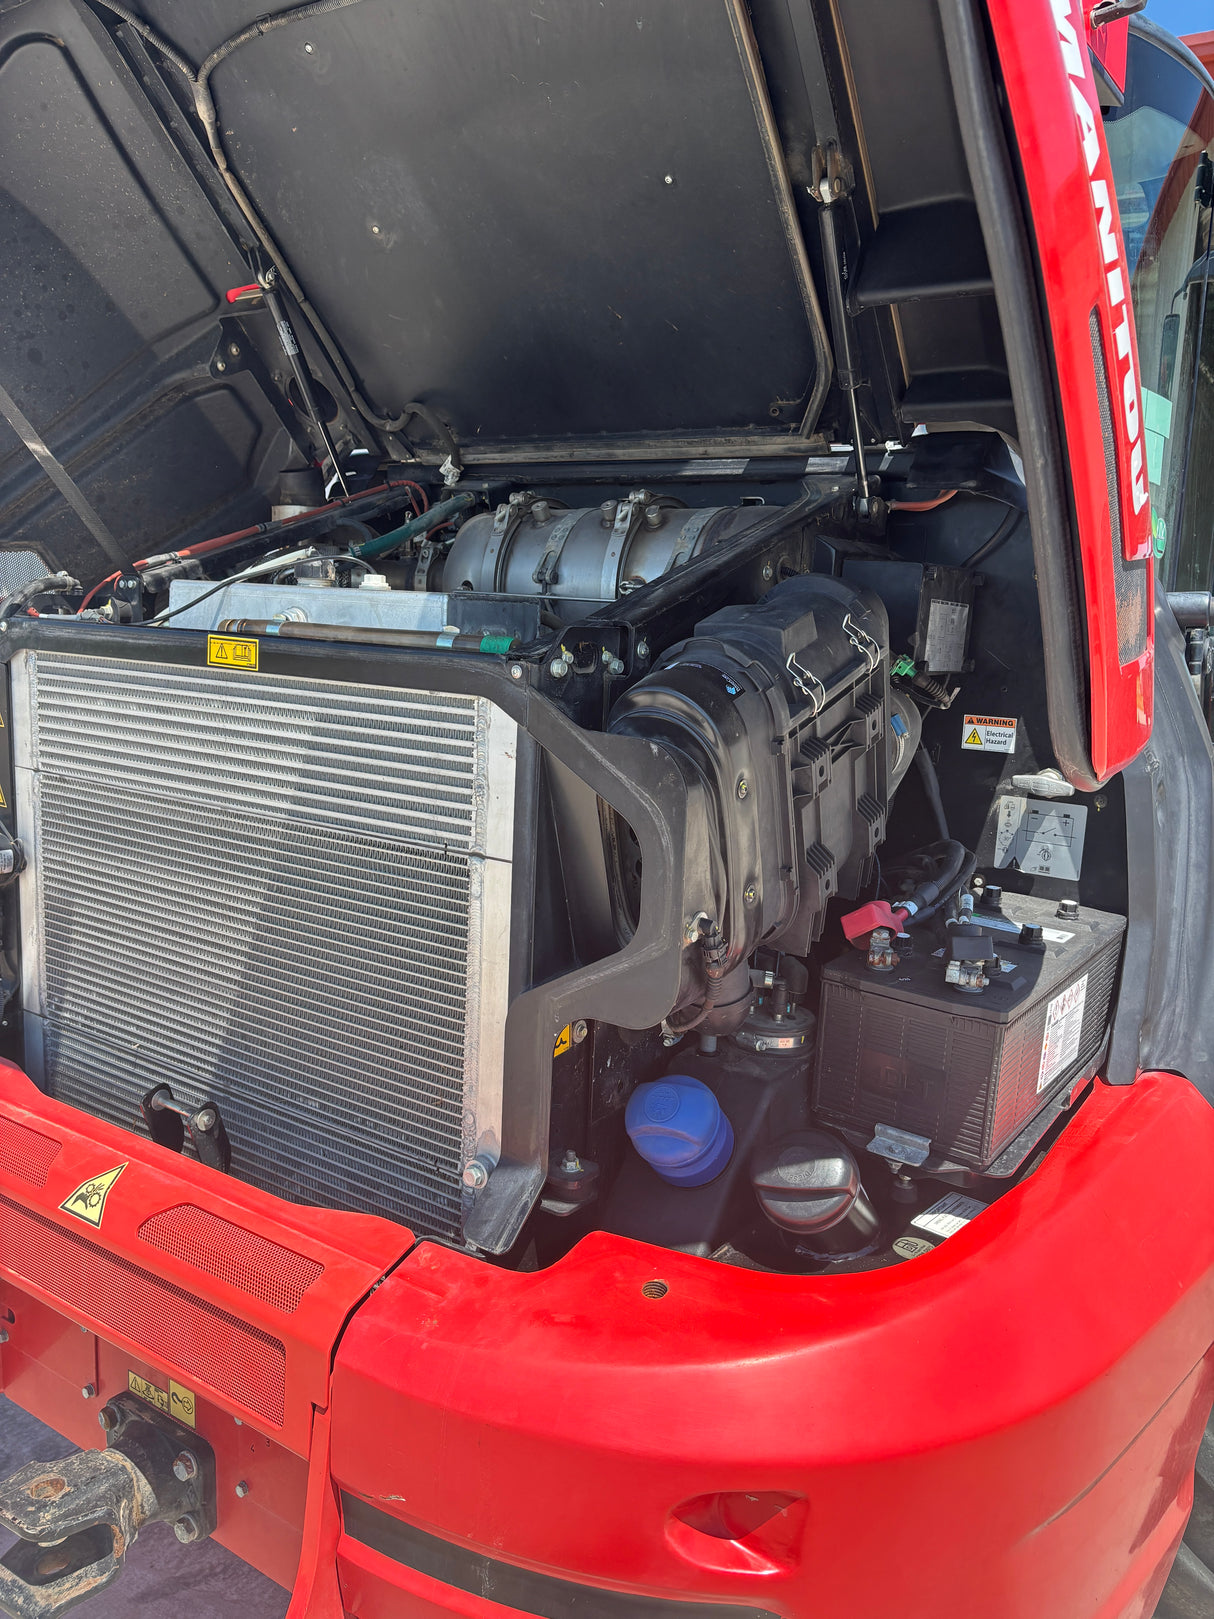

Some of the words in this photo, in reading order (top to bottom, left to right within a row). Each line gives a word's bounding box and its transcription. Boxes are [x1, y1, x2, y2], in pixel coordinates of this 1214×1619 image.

[1050, 0, 1149, 515] MANITOU
[976, 717, 1014, 727] WARNING
[986, 730, 1014, 739] Electrical
[985, 737, 1007, 746] Hazard
